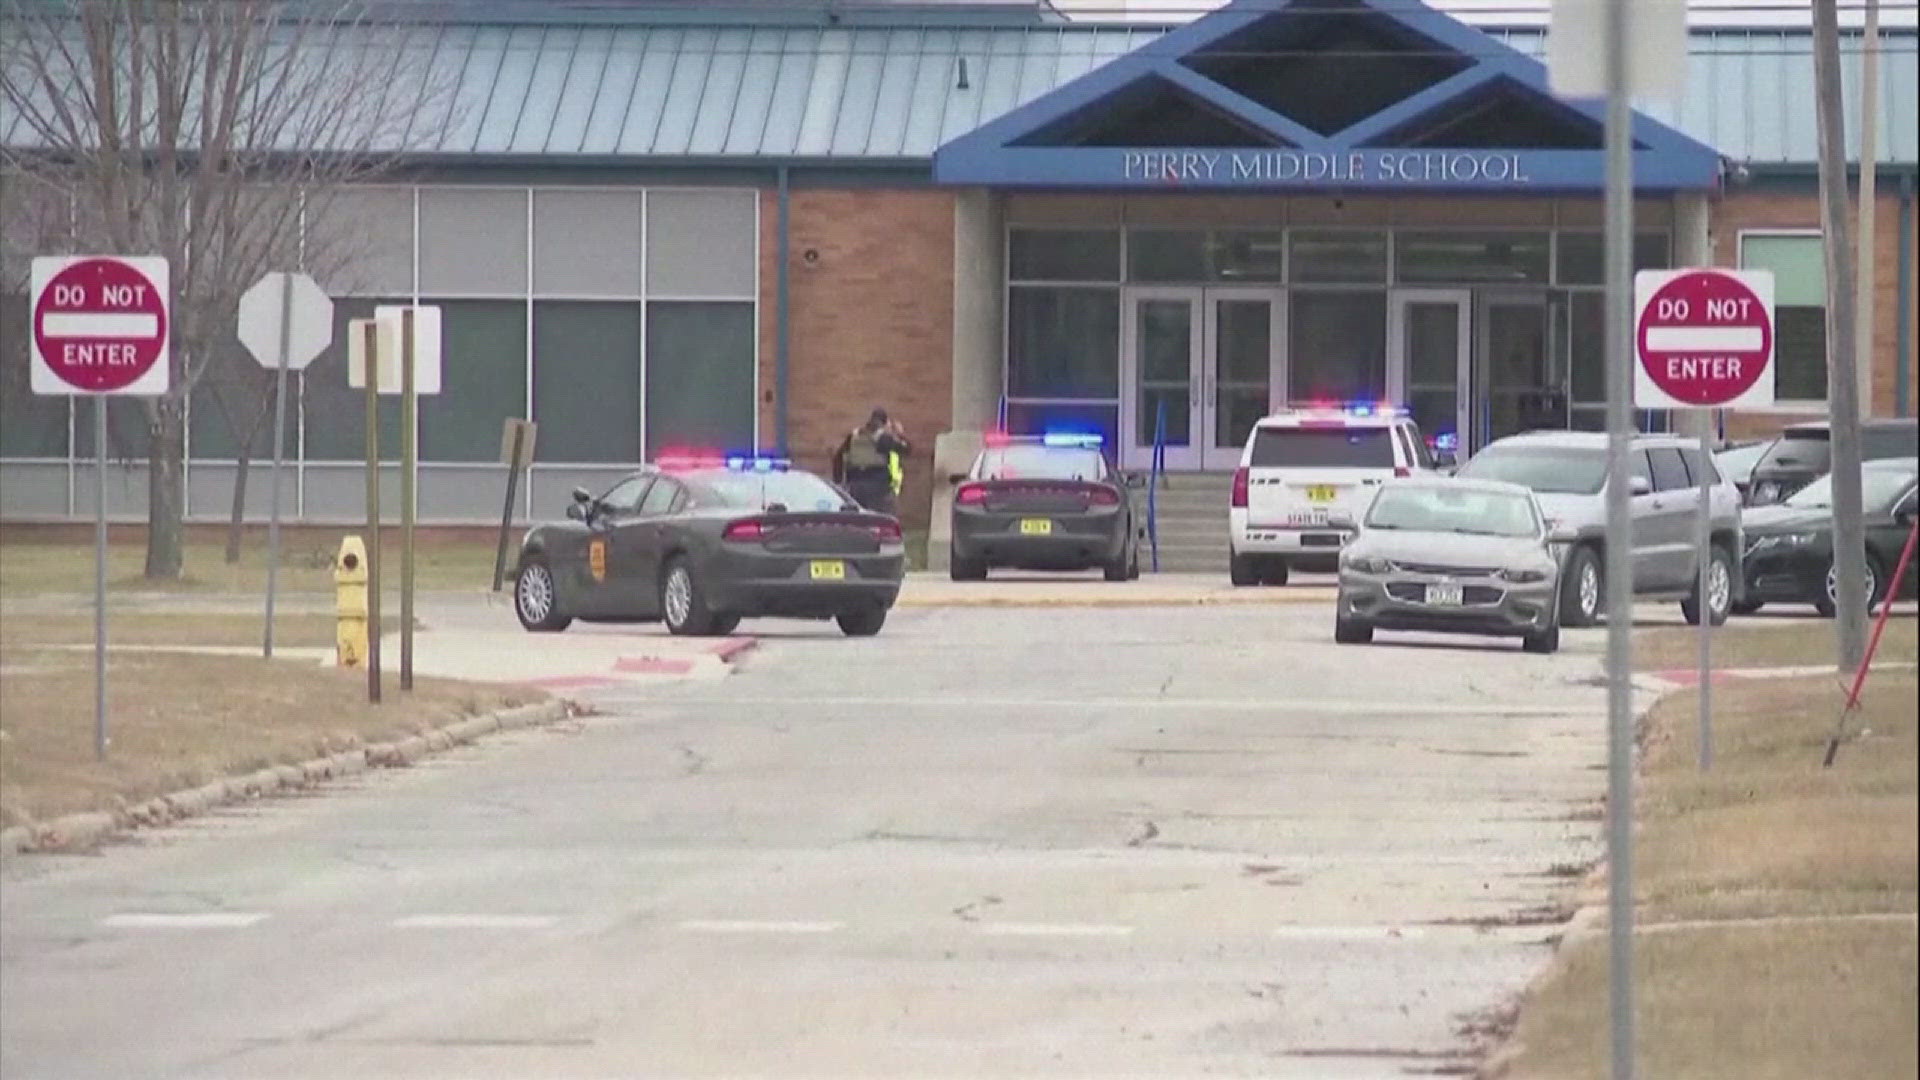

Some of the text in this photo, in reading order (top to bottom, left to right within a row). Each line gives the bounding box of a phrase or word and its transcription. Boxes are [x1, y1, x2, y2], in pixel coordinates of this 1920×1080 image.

[1123, 152, 1529, 182] PERRY MIDDLE SCHOOL
[55, 285, 147, 306] DO NOT
[1657, 299, 1751, 320] DO NOT
[63, 344, 137, 366] ENTER
[1666, 358, 1742, 380] ENTER
